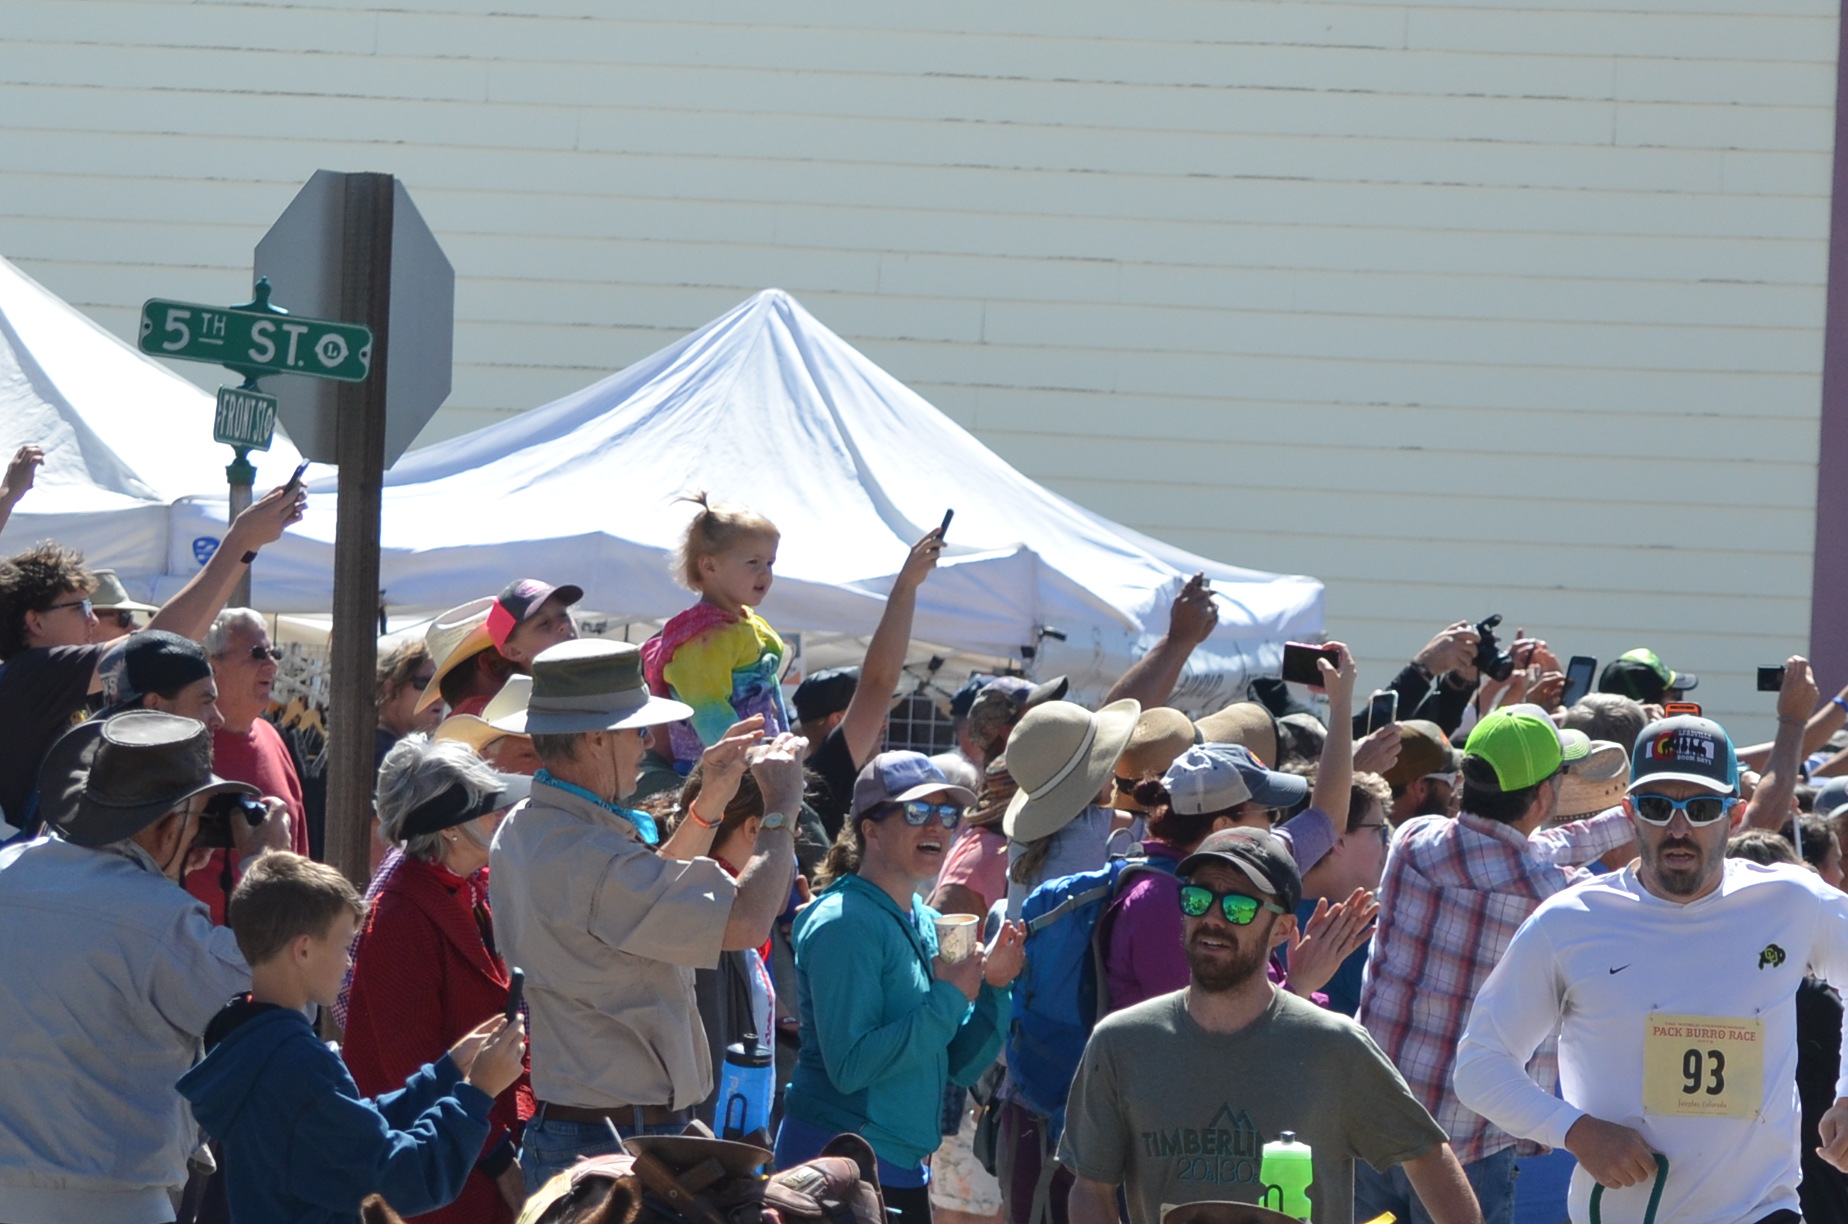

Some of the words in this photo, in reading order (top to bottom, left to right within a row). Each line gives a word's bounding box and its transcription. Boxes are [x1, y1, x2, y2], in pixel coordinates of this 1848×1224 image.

[248, 319, 308, 366] ST.
[220, 394, 256, 440] FRONT
[1677, 754, 1695, 762] BOOM
[1696, 756, 1712, 766] DAYS
[1653, 1026, 1683, 1037] PACK
[1686, 1028, 1726, 1040] BURRO
[1728, 1030, 1756, 1042] RACE
[1682, 1048, 1725, 1095] 93
[1142, 1128, 1265, 1158] TIMBERLI
